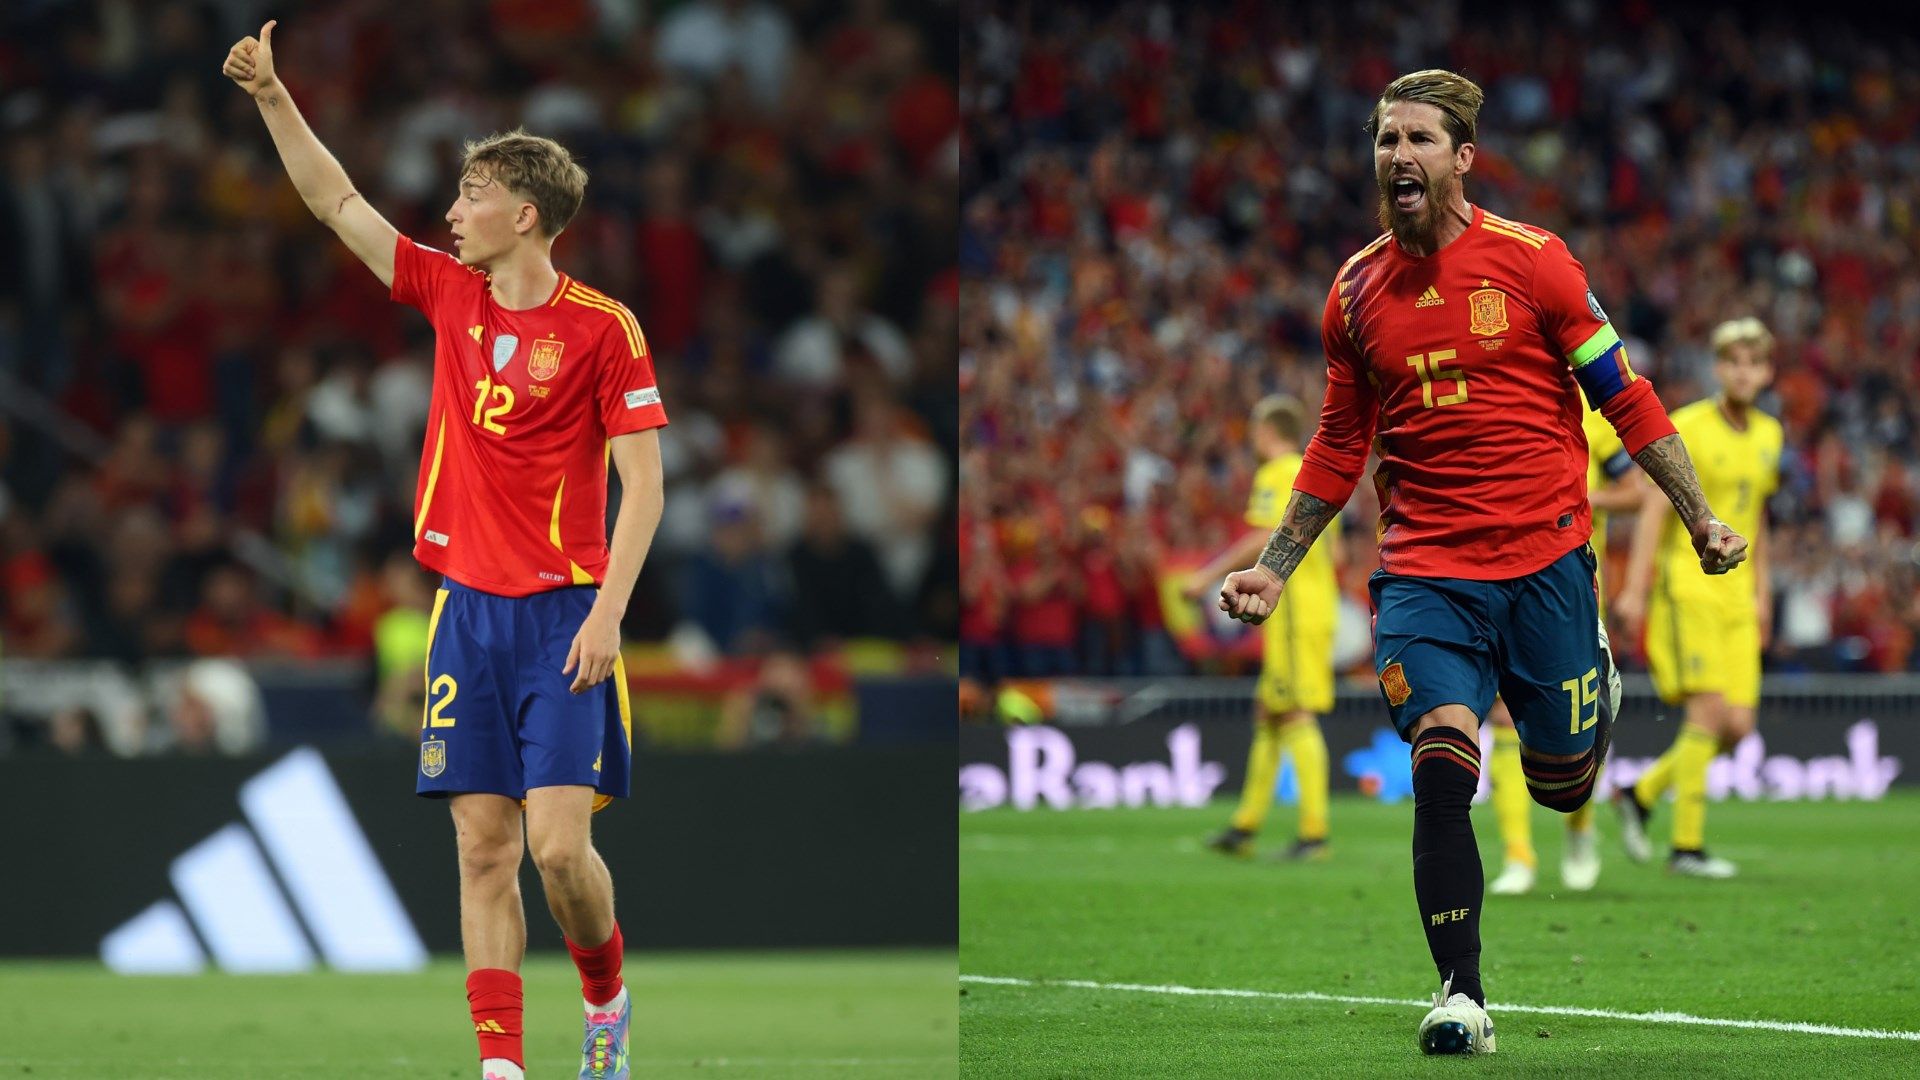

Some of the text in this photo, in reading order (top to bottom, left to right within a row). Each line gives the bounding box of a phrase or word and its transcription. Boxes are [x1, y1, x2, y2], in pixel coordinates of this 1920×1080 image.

[1414, 298, 1446, 309] adidas
[472, 374, 515, 436] 12
[1406, 348, 1469, 409] 15
[1561, 666, 1599, 735] 15
